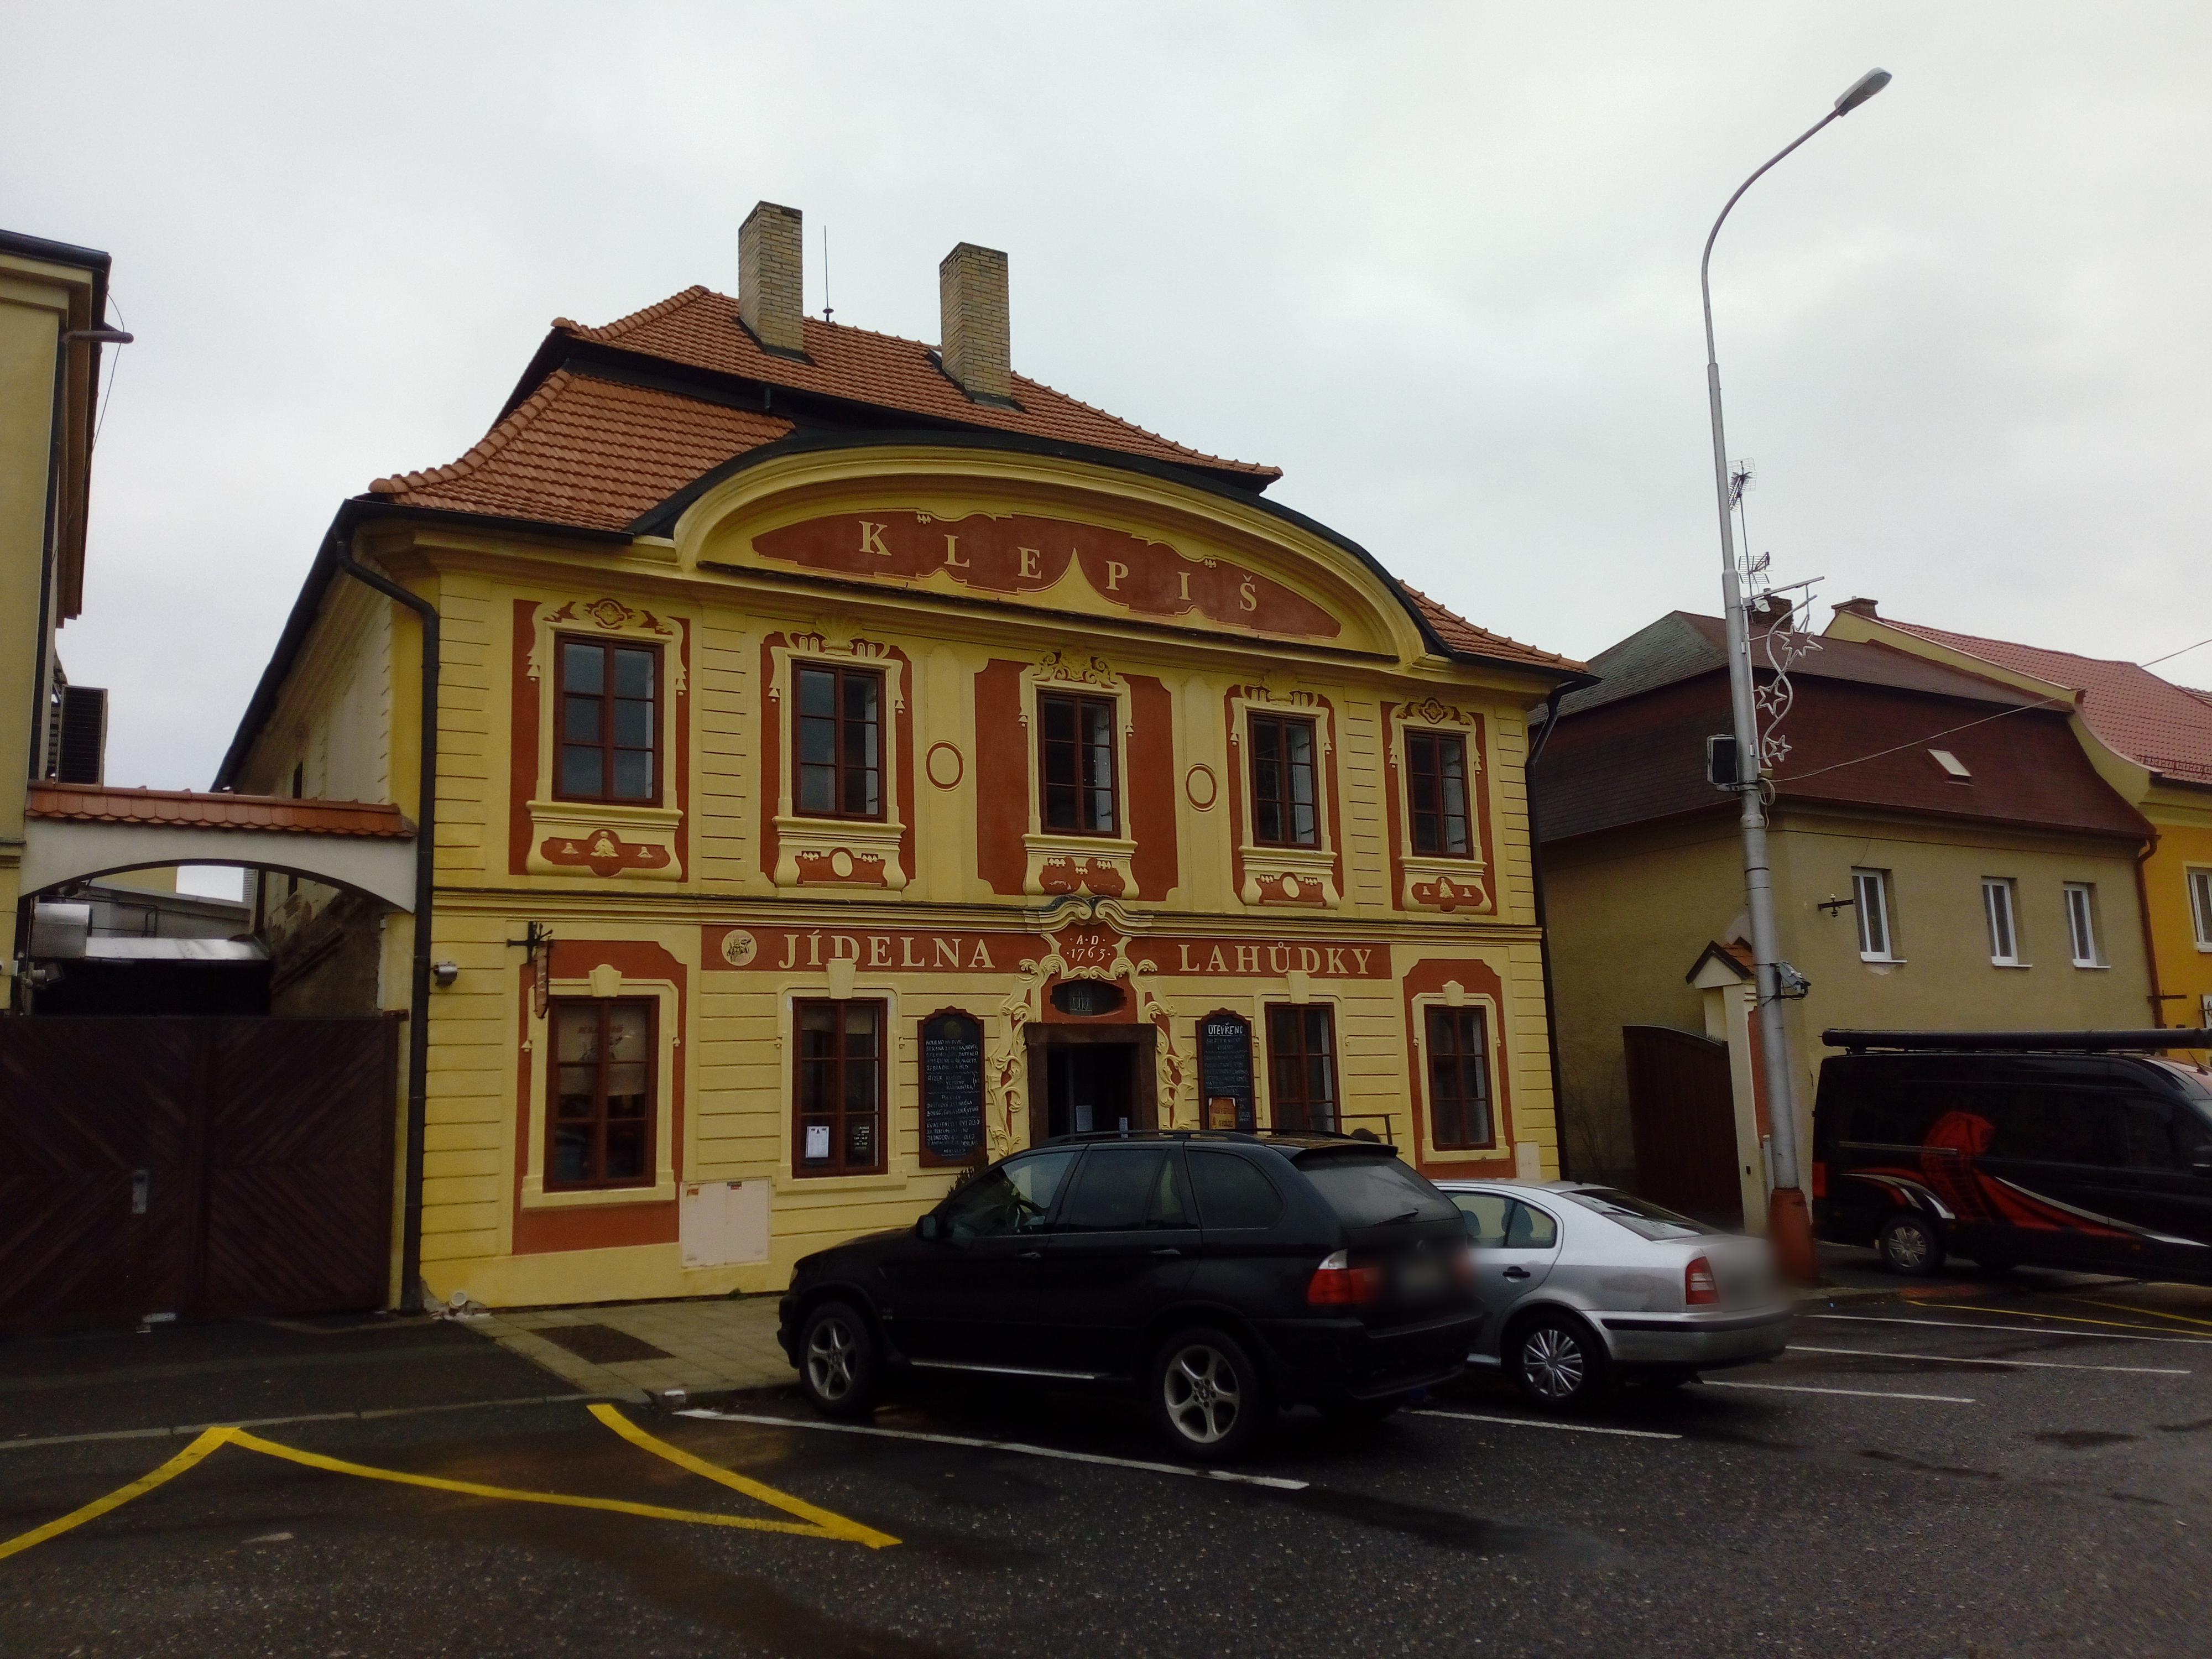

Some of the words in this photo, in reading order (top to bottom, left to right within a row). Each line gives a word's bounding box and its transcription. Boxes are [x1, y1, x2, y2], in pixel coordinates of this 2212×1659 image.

[859, 520, 1257, 611] KLEPIŠ
[778, 929, 996, 969] JÍDELNA
[1177, 941, 1373, 975] LAHŮDKY
